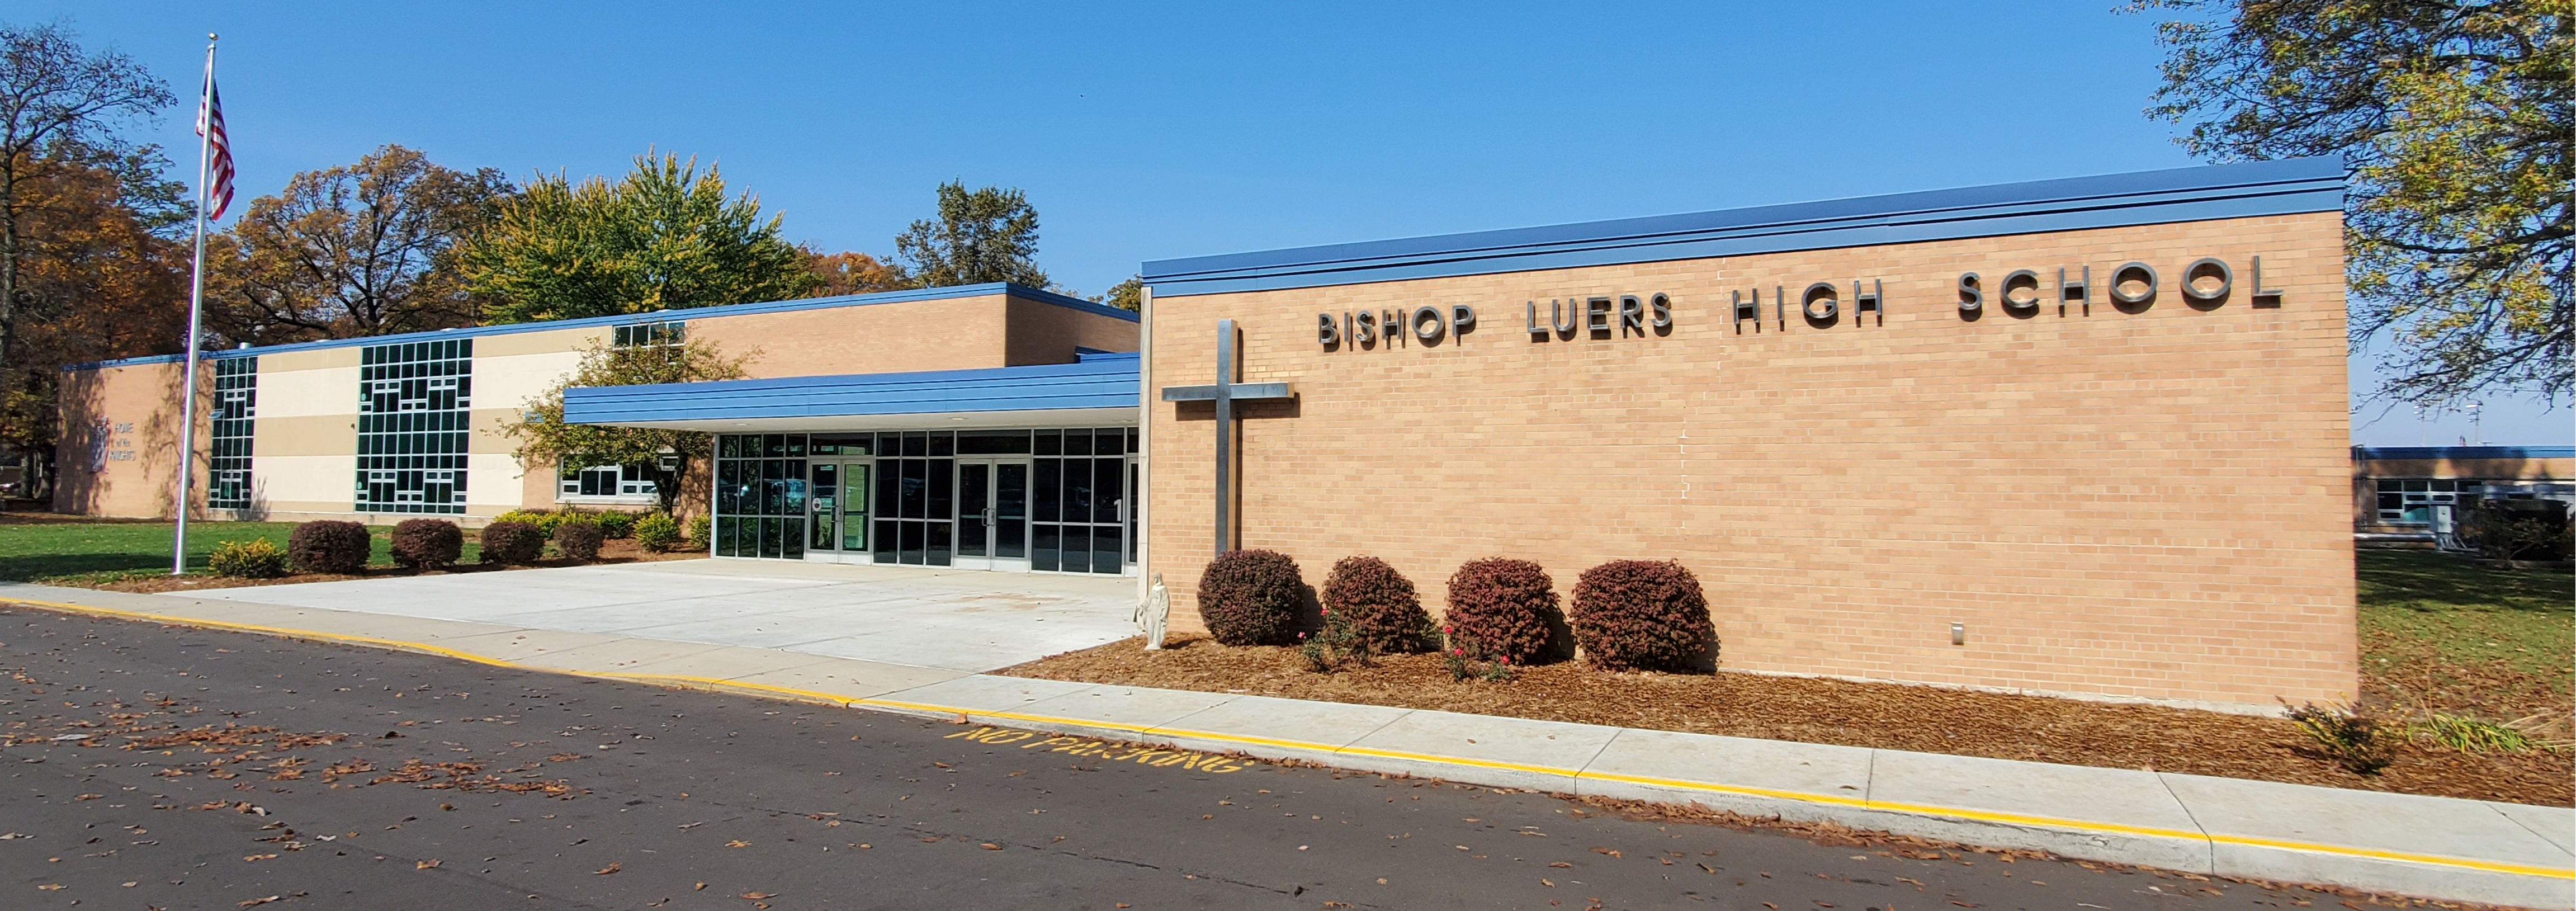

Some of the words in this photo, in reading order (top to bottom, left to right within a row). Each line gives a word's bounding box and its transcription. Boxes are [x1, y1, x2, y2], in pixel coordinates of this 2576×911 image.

[1318, 305, 1476, 344] BISHOP
[1527, 291, 1672, 334] LUERS
[1732, 278, 1883, 325] HIGH
[1958, 255, 2284, 312] SCHOOL
[114, 422, 134, 434] HOME
[110, 450, 136, 461] KNIGHTS
[1114, 499, 1122, 521] 1
[942, 727, 1033, 744] NO
